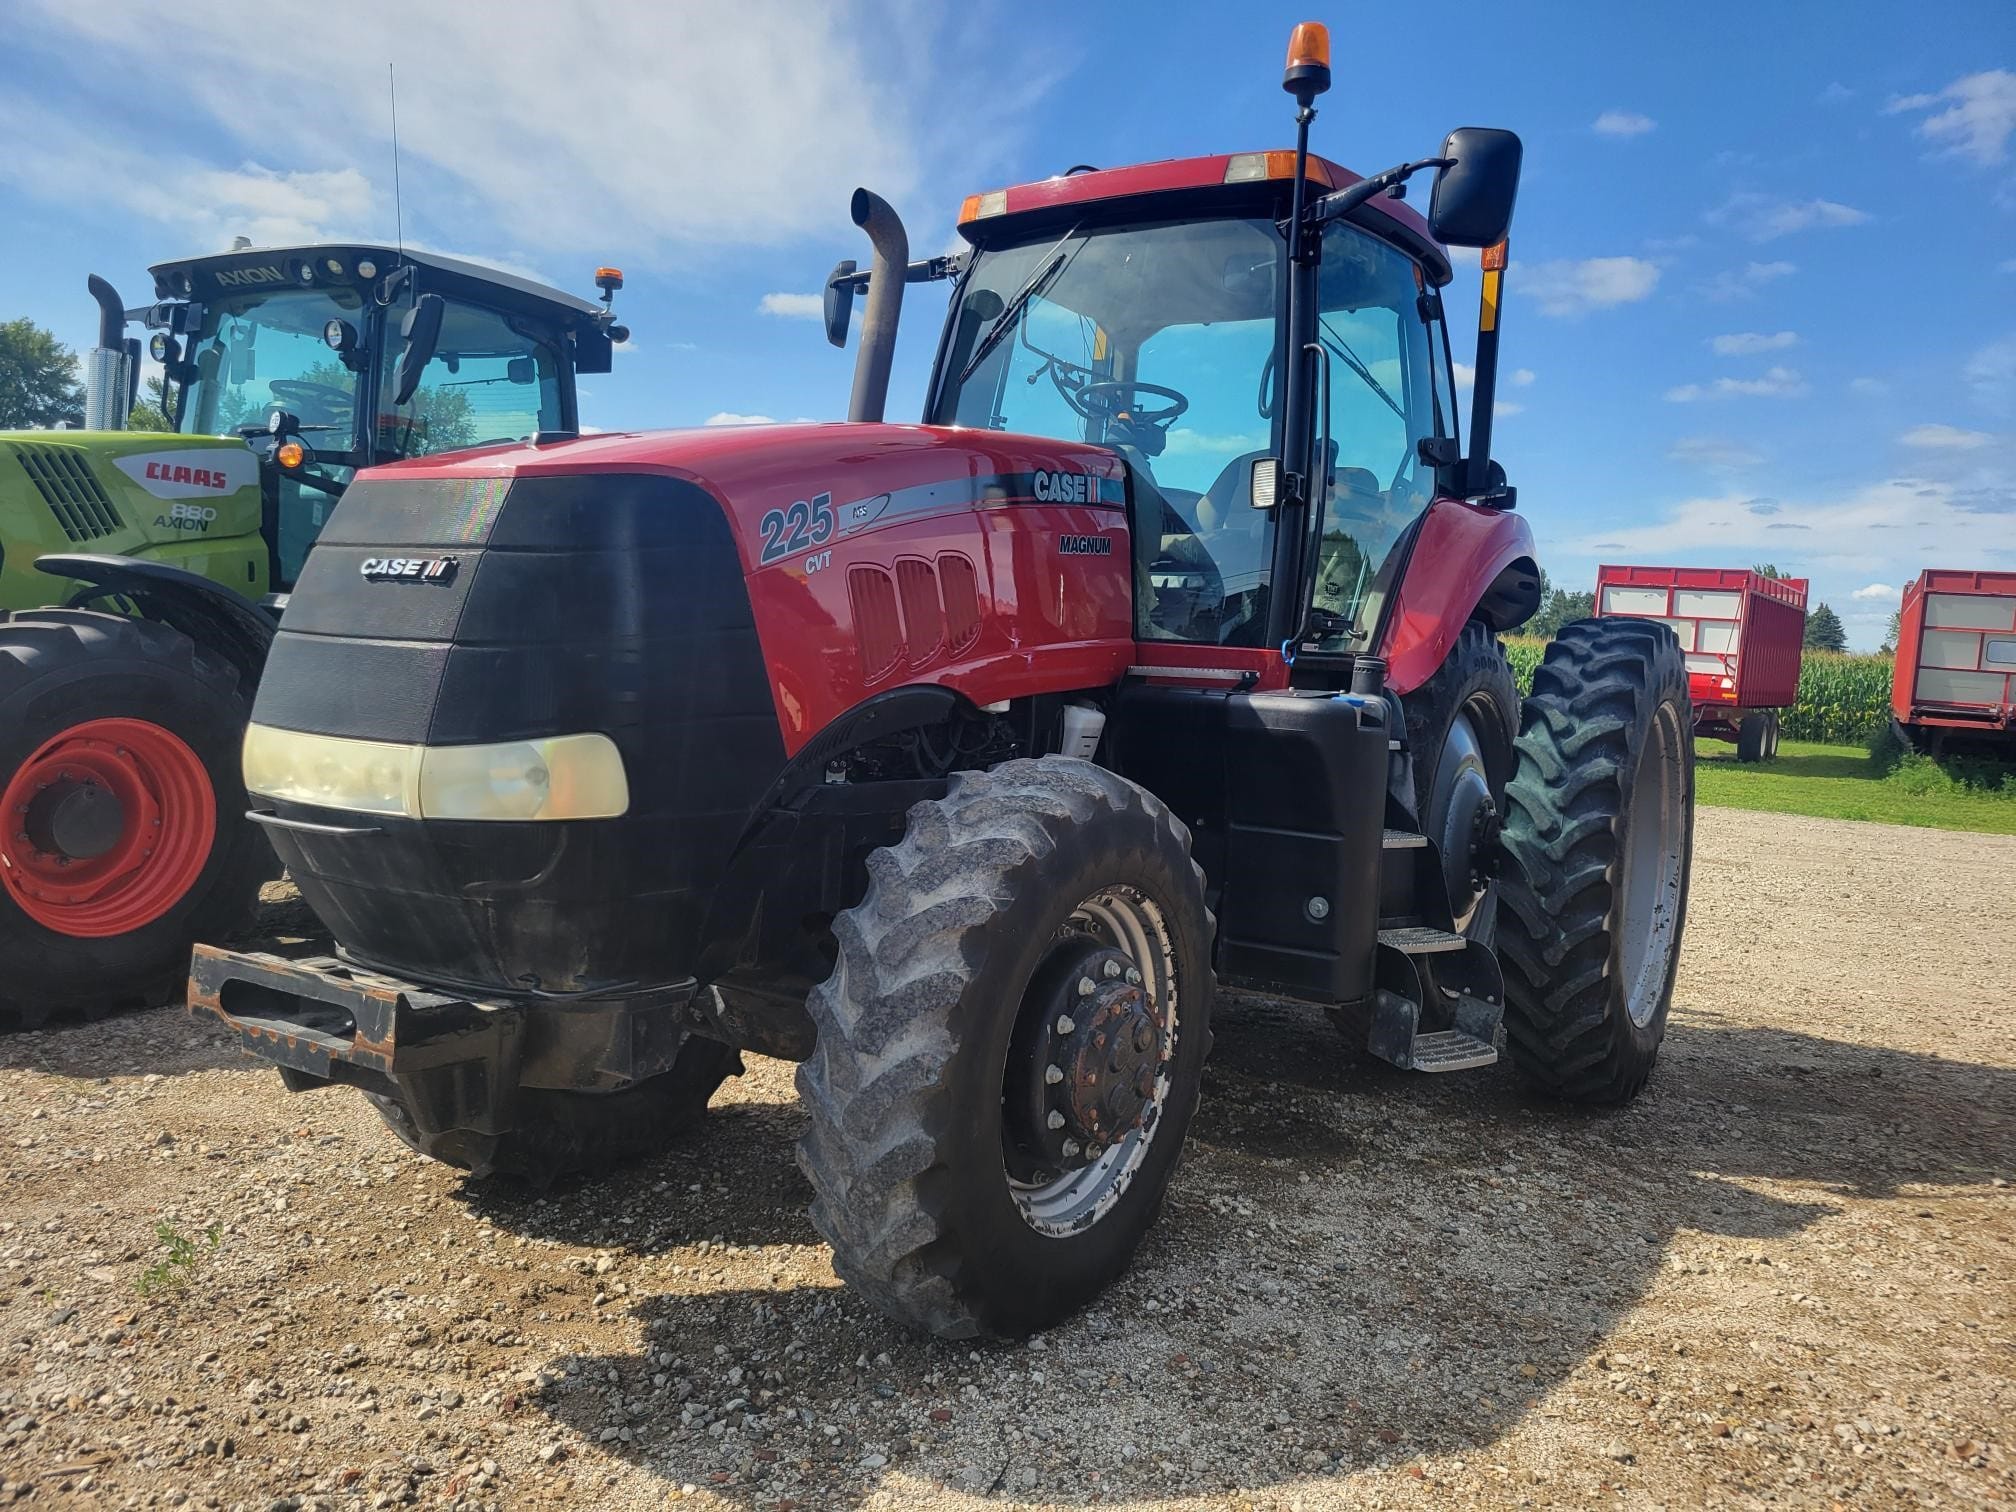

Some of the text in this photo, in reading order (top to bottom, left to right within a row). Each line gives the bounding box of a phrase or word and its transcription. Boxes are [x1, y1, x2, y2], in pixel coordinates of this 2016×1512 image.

[215, 266, 285, 286] AXION
[145, 462, 226, 489] CLAAS
[1034, 469, 1085, 503] CASE
[153, 515, 209, 532] AXION
[171, 503, 217, 522] 880
[760, 490, 834, 566] 225
[1059, 534, 1112, 556] MAGNUM
[360, 558, 422, 576] CASE
[805, 550, 832, 575] CVT
